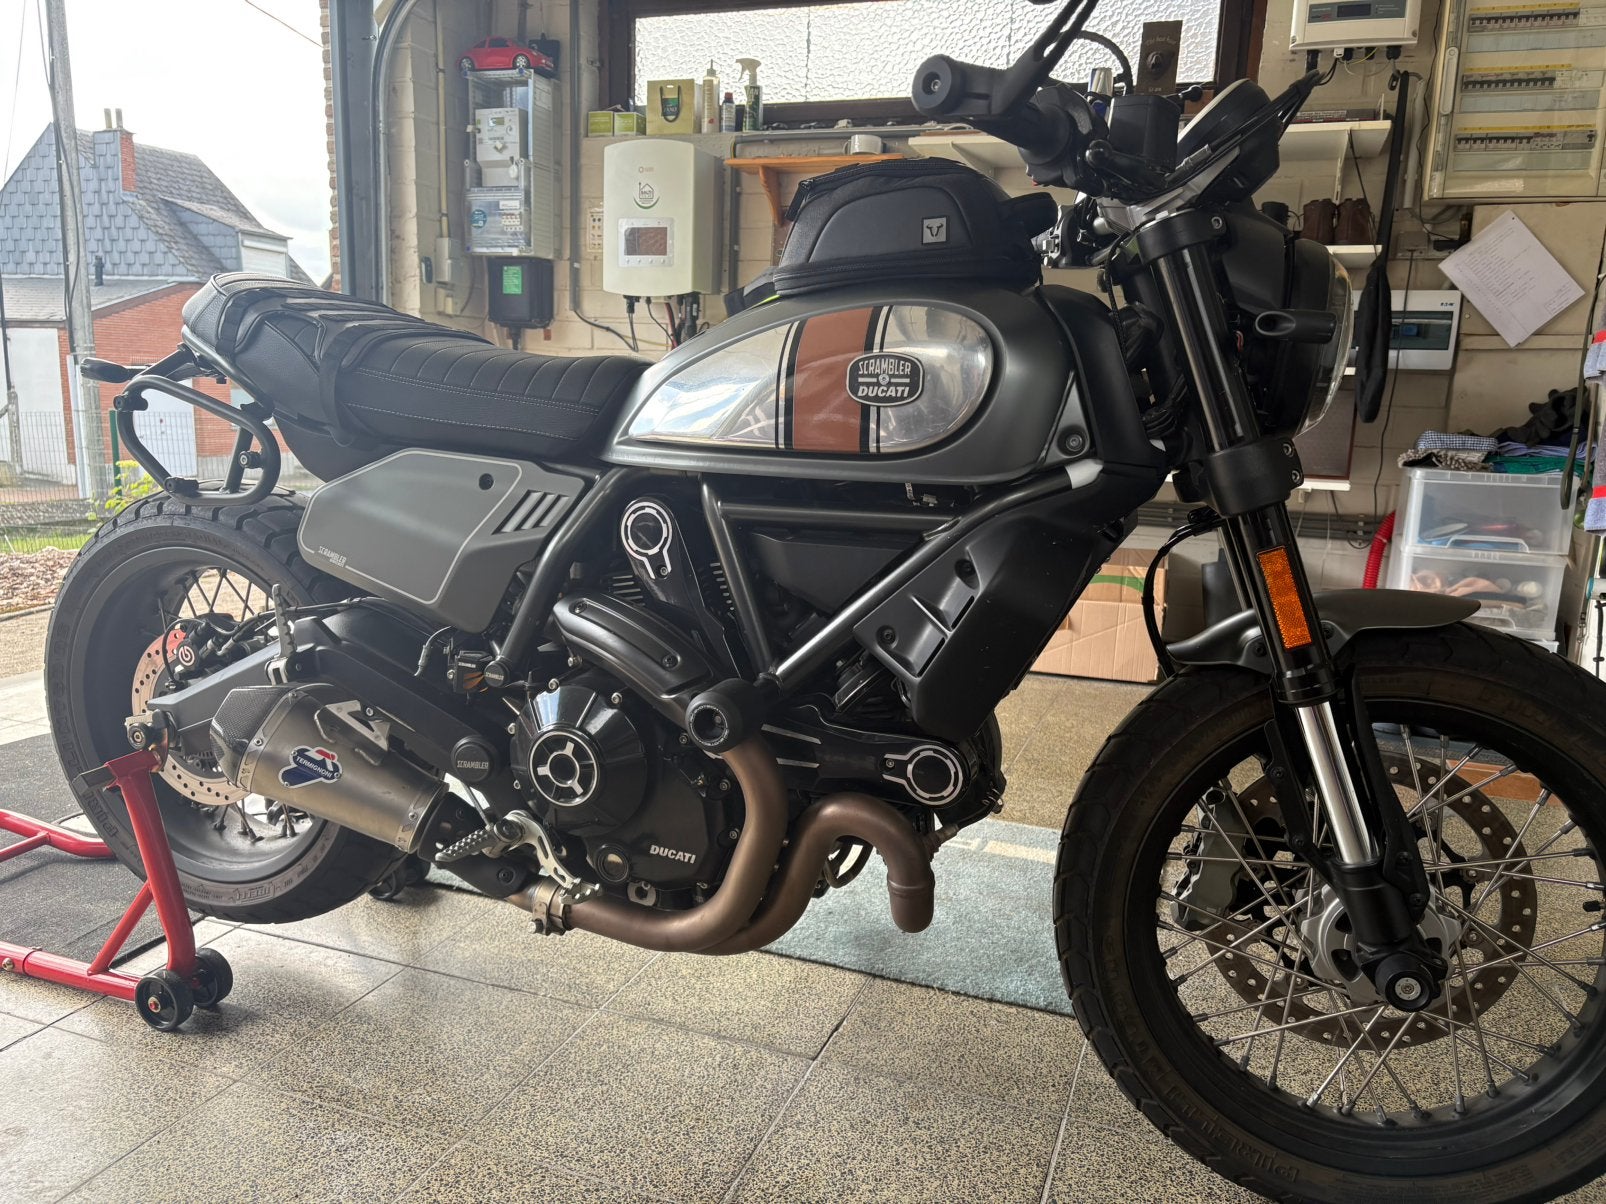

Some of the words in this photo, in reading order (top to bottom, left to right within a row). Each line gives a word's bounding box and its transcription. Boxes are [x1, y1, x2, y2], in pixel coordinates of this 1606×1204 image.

[858, 358, 911, 375] SCRAMBLER
[857, 386, 910, 397] DUCATI
[296, 755, 333, 778] TERMIGNONI
[456, 760, 489, 770] SCRAMBLER
[649, 844, 697, 864] DUCATI
